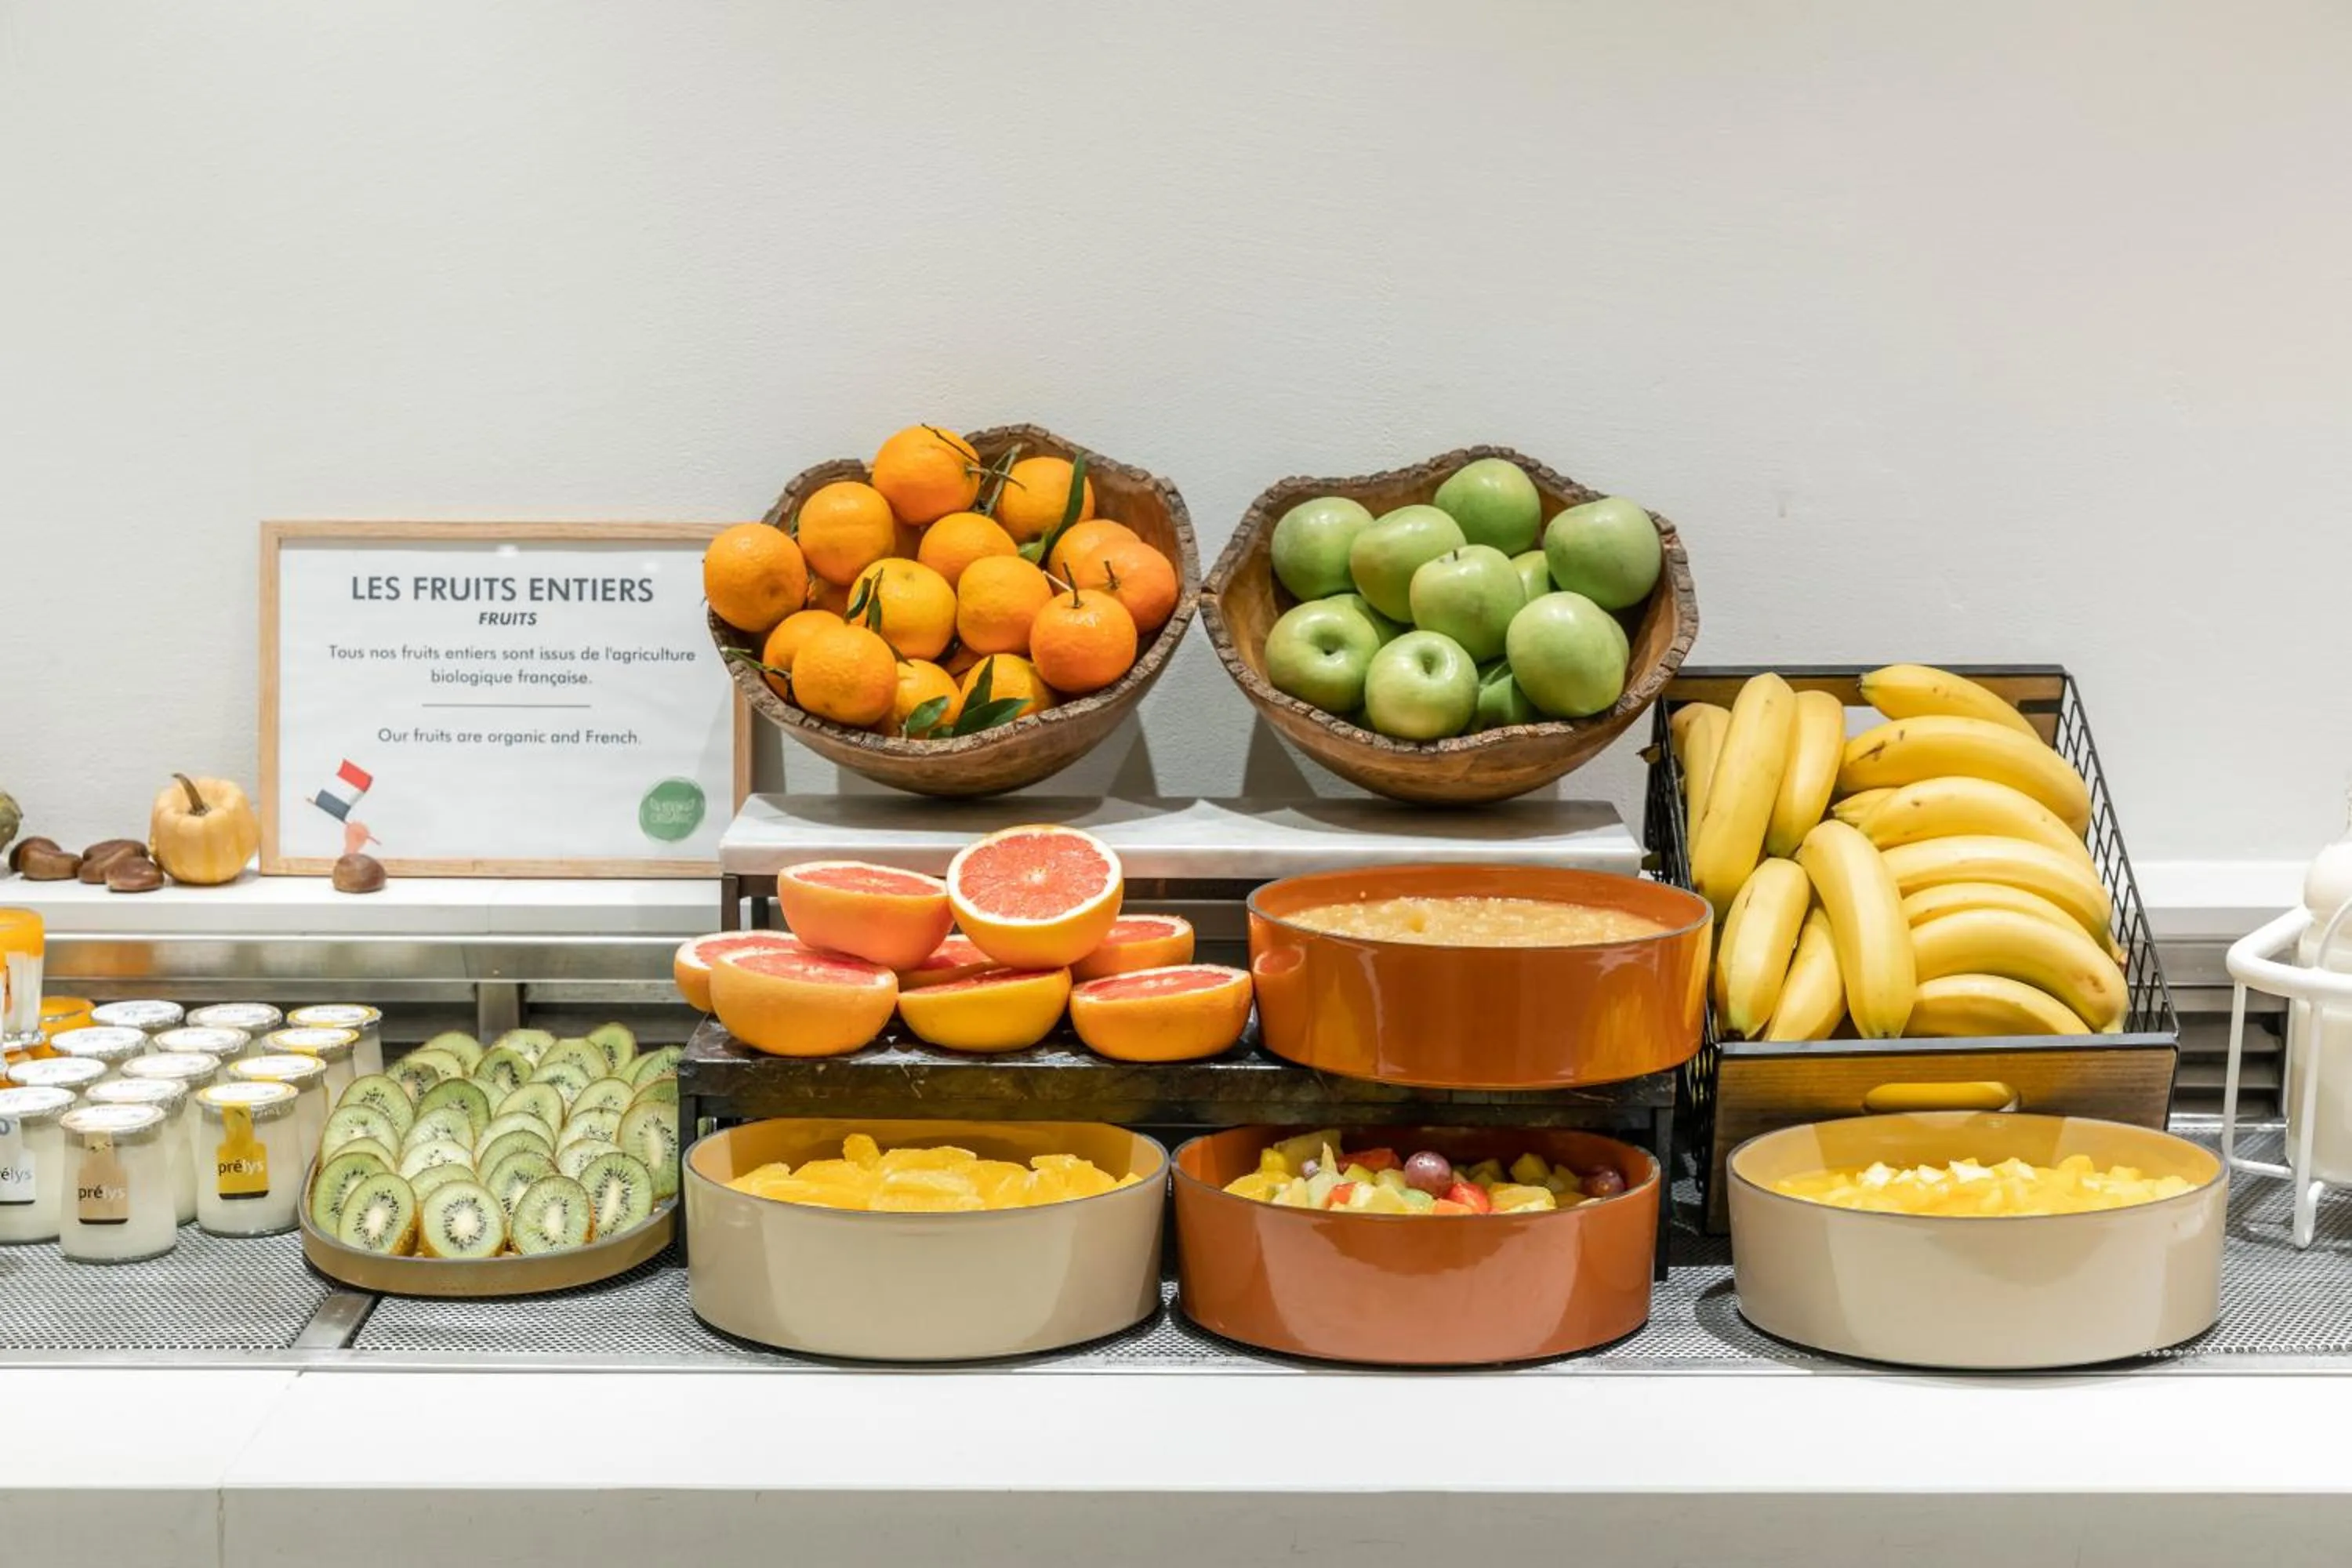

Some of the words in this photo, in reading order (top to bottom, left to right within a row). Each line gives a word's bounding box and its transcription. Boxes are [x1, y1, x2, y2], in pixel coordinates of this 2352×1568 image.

[351, 575, 401, 601] LES
[413, 575, 517, 602] FRUITS
[528, 577, 655, 603] ENTIERS
[477, 611, 538, 626] FRUITS
[328, 644, 365, 659] Tous
[369, 649, 397, 659] nos
[401, 644, 441, 659] fruits
[445, 646, 497, 660] entiers
[502, 647, 535, 661] sont
[539, 647, 576, 661] issus
[580, 646, 600, 662] de
[604, 646, 696, 665] l'agriculture
[430, 669, 514, 687] biologique
[517, 668, 593, 688] française.
[377, 728, 408, 742] Our
[413, 727, 452, 743] fruits
[456, 732, 482, 743] are
[487, 729, 546, 747] organic
[550, 729, 580, 744] and
[585, 729, 642, 745] French.
[0, 1167, 32, 1184] élys
[218, 1158, 264, 1177] prélys
[78, 1184, 126, 1201] prélys
